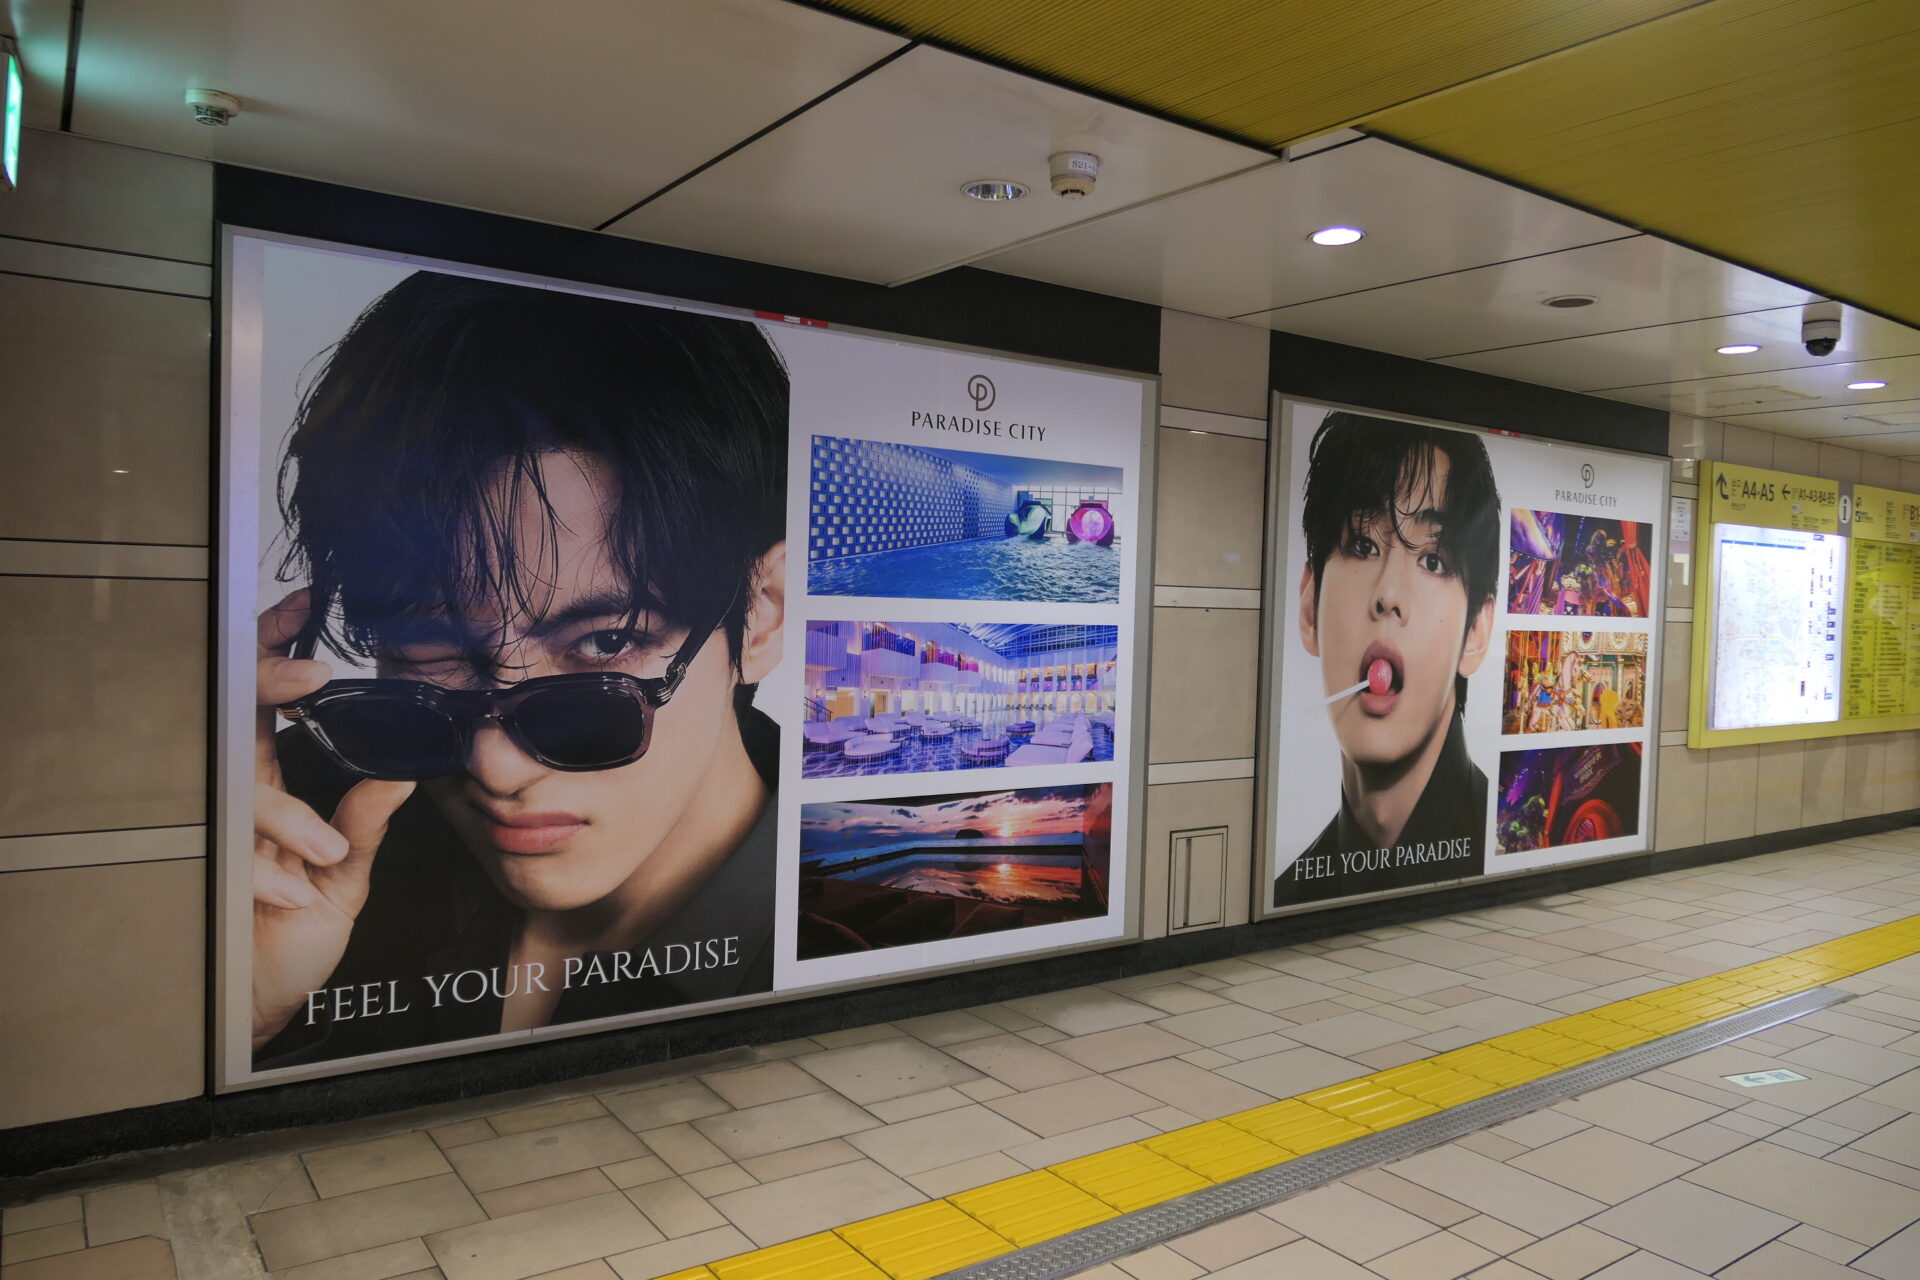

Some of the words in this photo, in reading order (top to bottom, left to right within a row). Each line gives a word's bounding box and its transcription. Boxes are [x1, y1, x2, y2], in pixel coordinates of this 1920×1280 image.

[911, 411, 1002, 437] PARADISE
[1008, 423, 1046, 441] CITY
[1555, 489, 1598, 506] PARADISE
[1599, 495, 1617, 508] CITY
[1294, 855, 1335, 881] FEEL
[1341, 848, 1391, 874] YOUR
[1395, 837, 1471, 867] PARADISE
[304, 980, 410, 1026] FEEL
[423, 961, 551, 1008] YOUR
[563, 936, 740, 989] PARADISE
